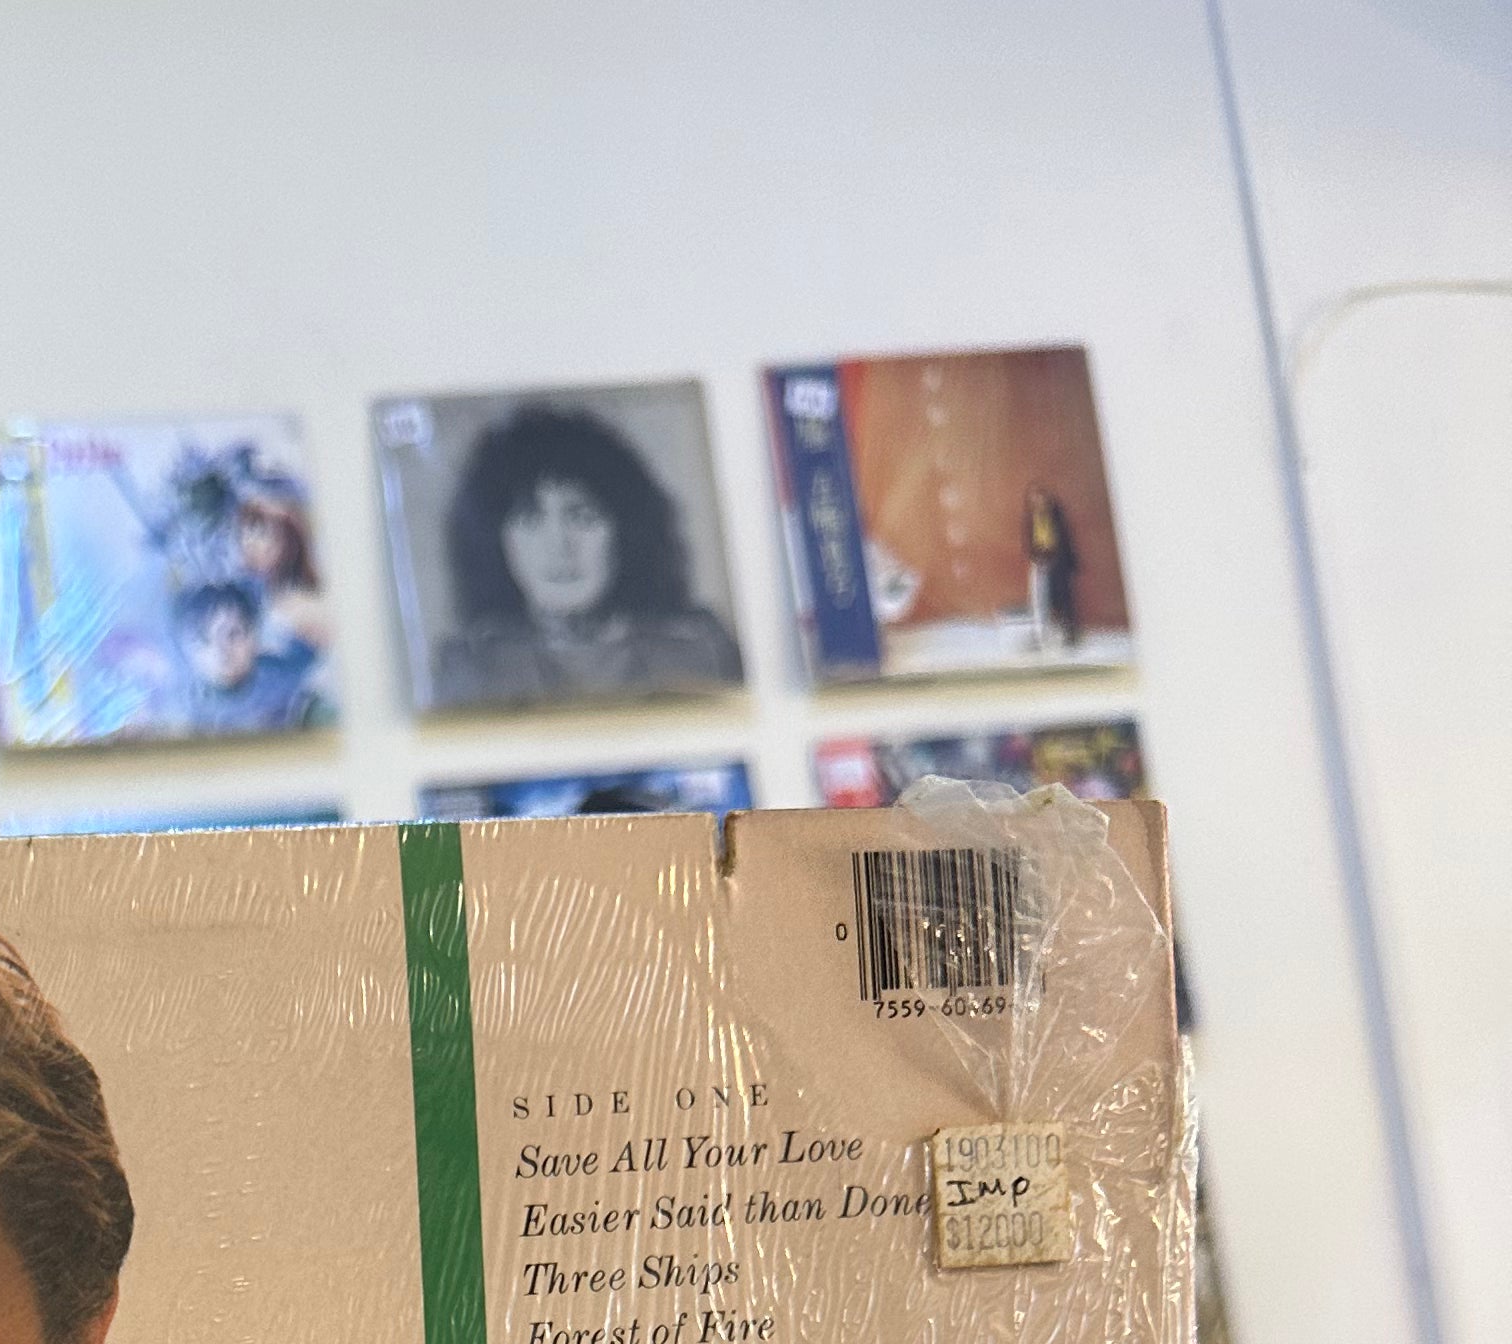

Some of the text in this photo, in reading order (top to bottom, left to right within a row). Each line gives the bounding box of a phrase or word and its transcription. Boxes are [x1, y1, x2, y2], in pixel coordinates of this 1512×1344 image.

[835, 923, 848, 941] 0
[513, 1084, 768, 1119] SIDE ONE
[516, 1131, 863, 1178] Save All Your Love
[520, 1185, 930, 1237] Easier Said than Done
[522, 1254, 739, 1296] Three Ships
[697, 1310, 775, 1344] Fire
